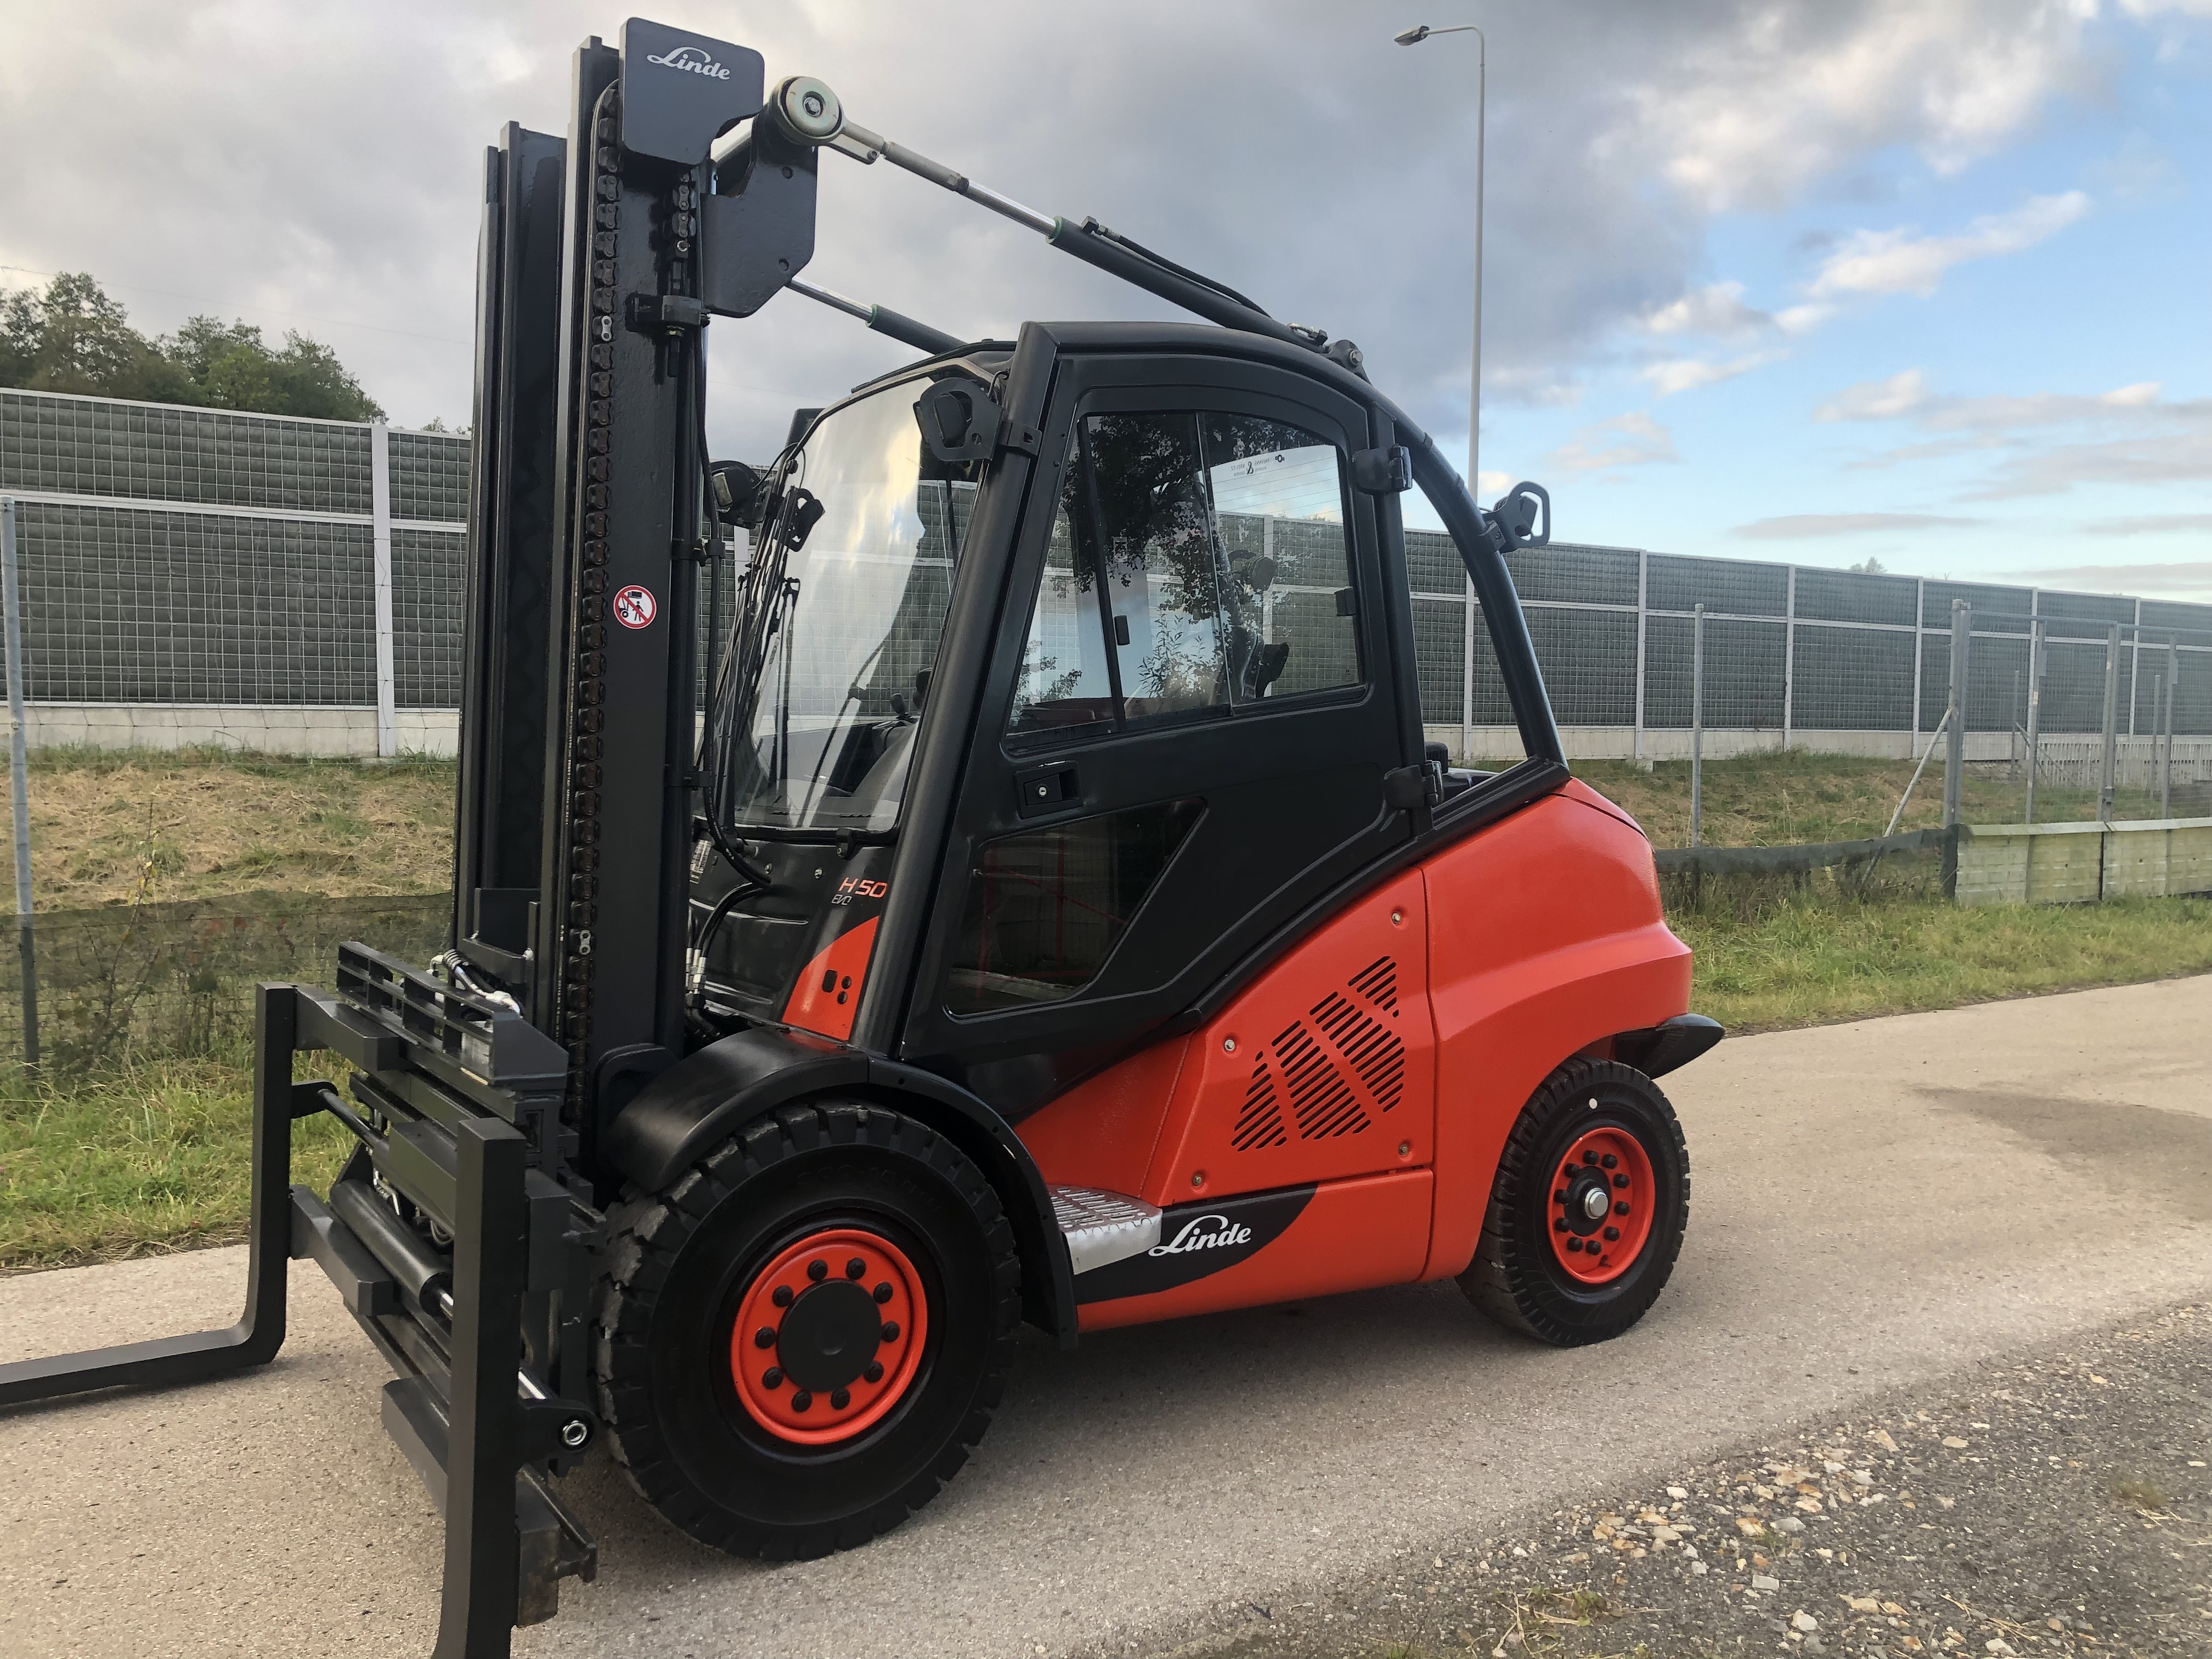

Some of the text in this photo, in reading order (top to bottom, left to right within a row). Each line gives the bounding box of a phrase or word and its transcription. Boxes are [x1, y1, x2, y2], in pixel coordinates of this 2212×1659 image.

[647, 46, 731, 80] Linde
[831, 894, 853, 906] EVO
[1148, 1215, 1251, 1257] Linde
